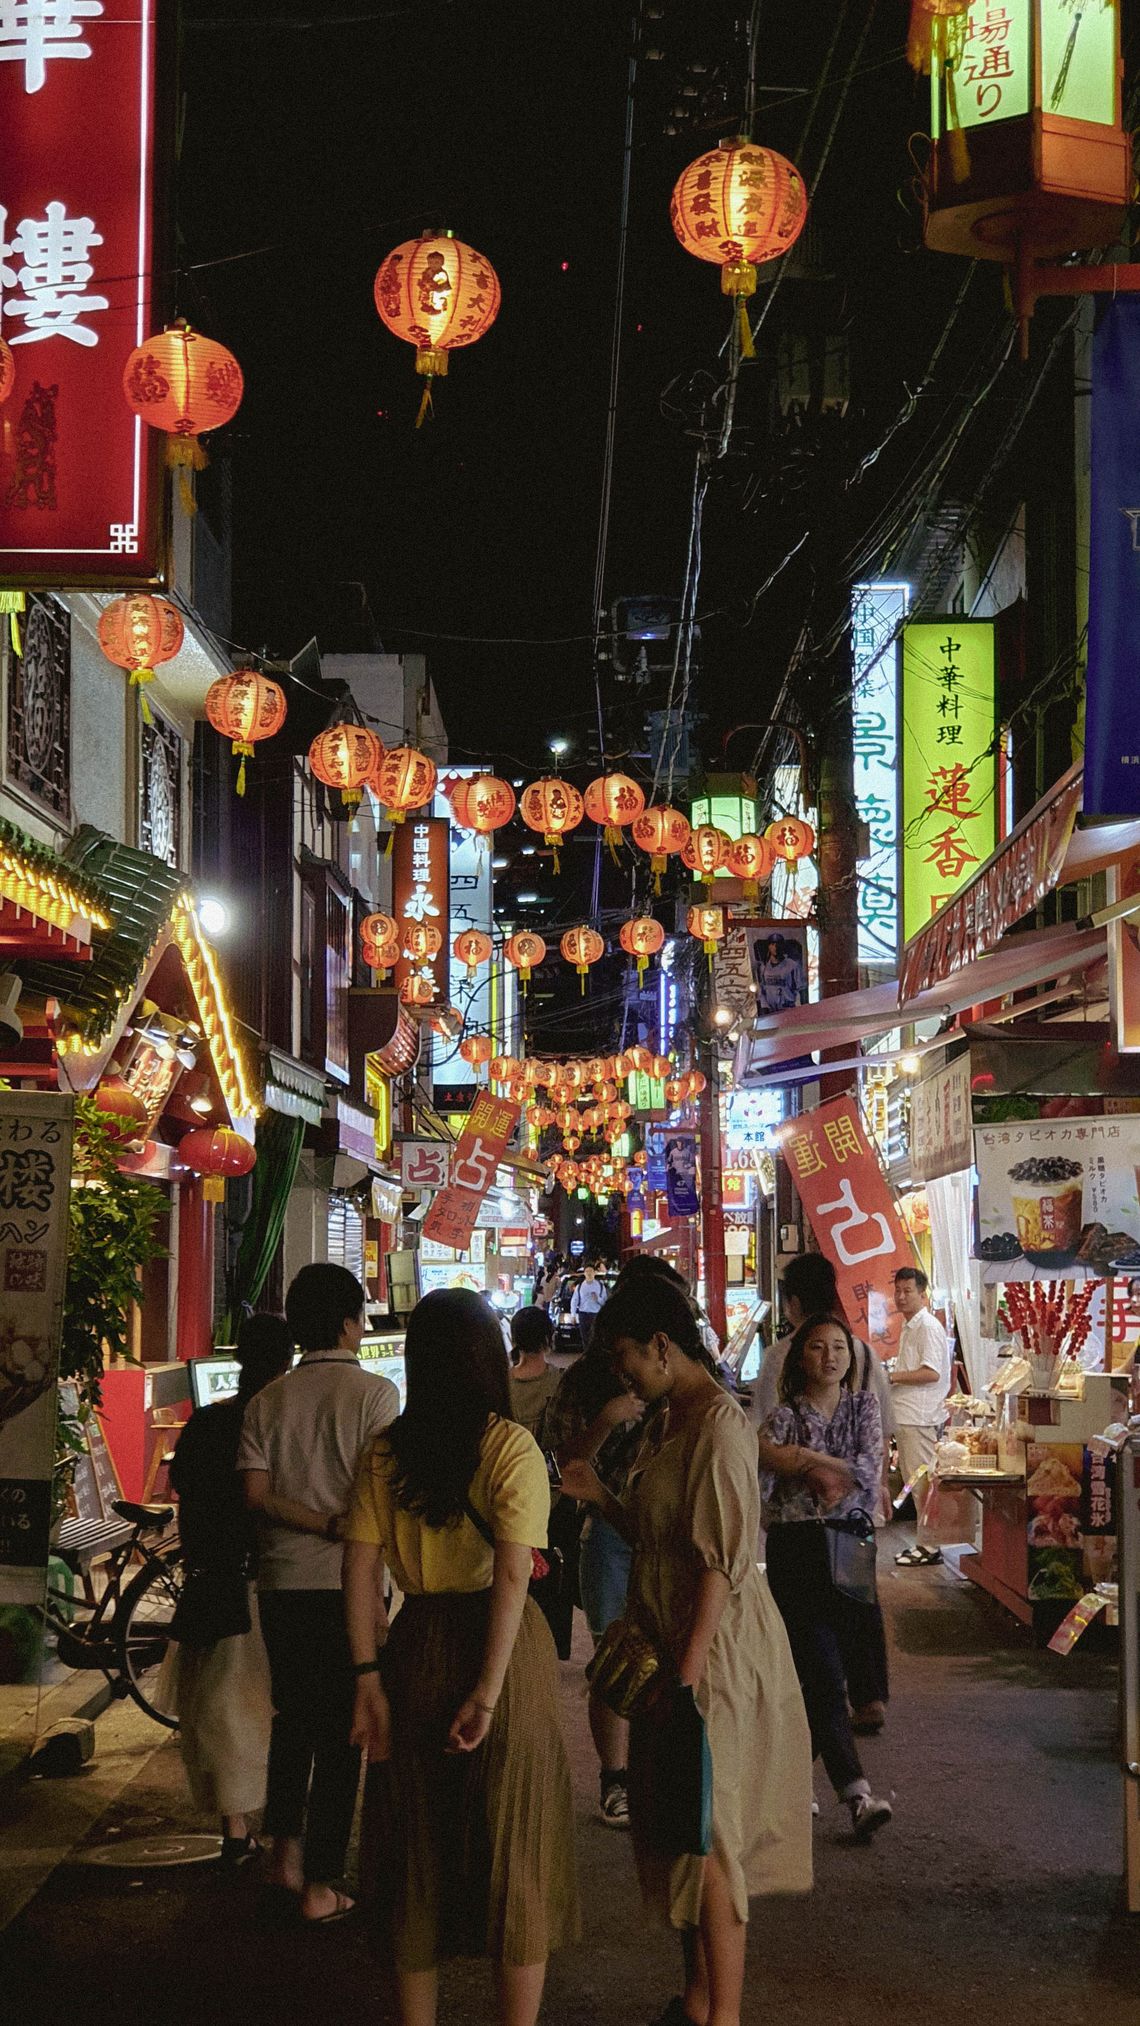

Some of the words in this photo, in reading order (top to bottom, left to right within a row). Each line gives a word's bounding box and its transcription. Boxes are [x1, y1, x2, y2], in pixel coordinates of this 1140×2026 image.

[963, 0, 1014, 117] 場通り
[936, 636, 965, 746] 中華料理
[411, 824, 433, 882] 中国料理
[924, 763, 981, 916] 蓮香
[0, 1118, 62, 1143] わる
[471, 1101, 514, 1139] 開運
[407, 1147, 445, 1186] 占
[450, 1137, 496, 1192] 占
